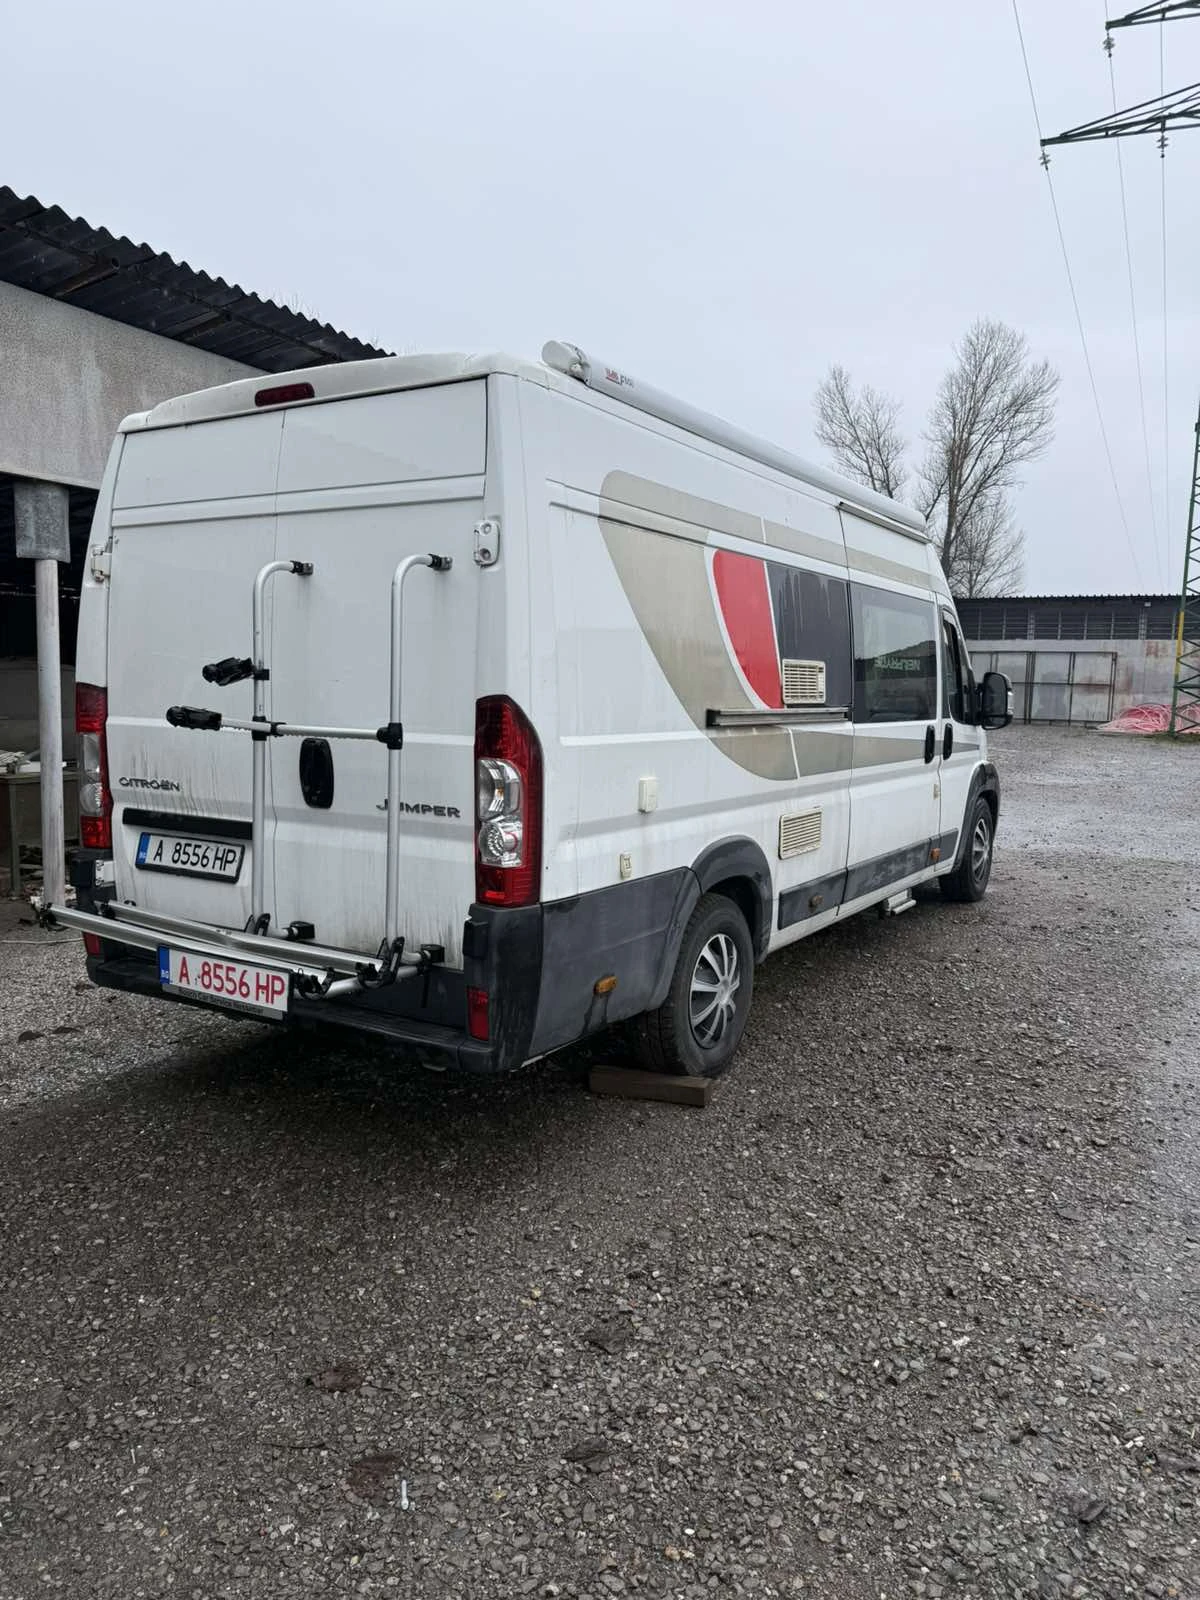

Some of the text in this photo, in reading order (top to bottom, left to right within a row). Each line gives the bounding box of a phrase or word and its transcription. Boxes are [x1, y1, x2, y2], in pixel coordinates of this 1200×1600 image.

[119, 777, 180, 792] CITROËN
[153, 839, 164, 862] A
[171, 841, 210, 868] 8556
[211, 846, 237, 872] HP
[178, 955, 191, 985] A
[201, 960, 250, 998] 8556
[255, 971, 286, 1005] HP
